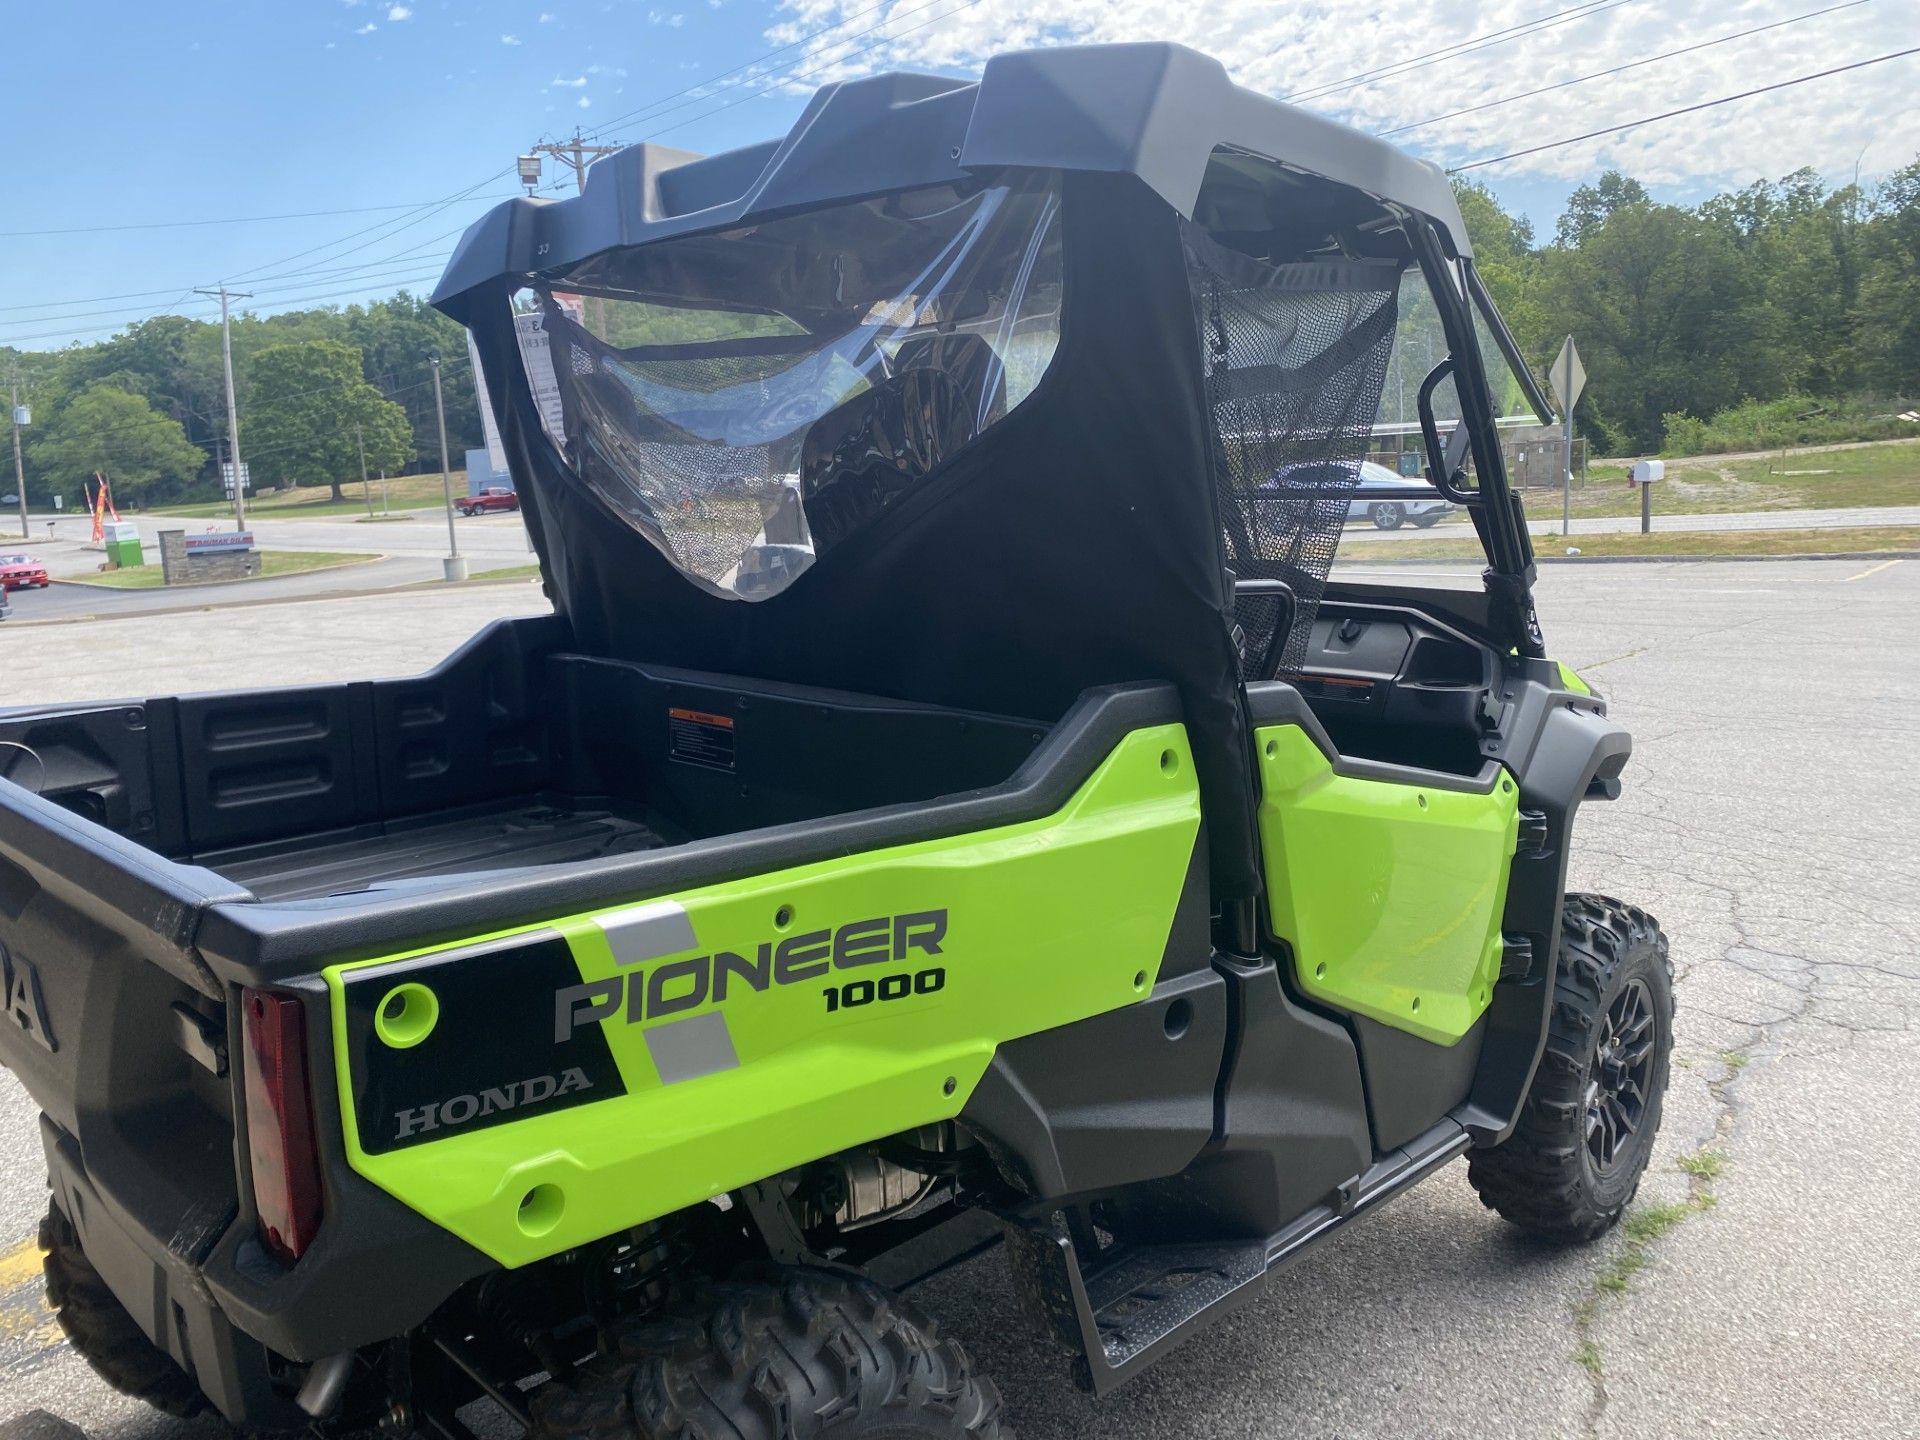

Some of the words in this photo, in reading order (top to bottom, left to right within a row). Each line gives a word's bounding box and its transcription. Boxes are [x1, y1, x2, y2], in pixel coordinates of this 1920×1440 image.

[554, 908, 949, 1045] PIONEER
[822, 967, 946, 1013] 1000
[394, 1066, 594, 1140] HONDA
